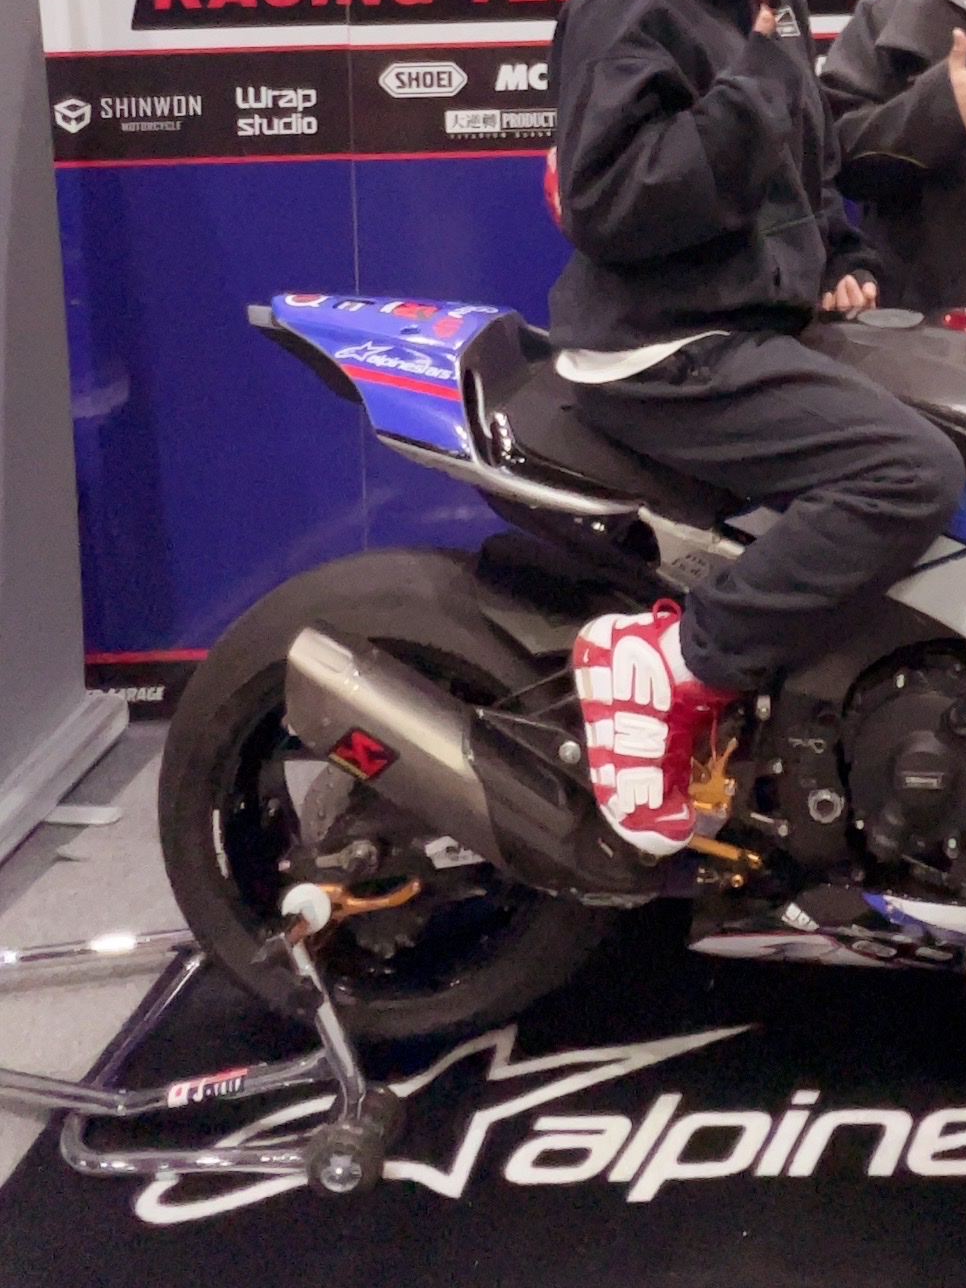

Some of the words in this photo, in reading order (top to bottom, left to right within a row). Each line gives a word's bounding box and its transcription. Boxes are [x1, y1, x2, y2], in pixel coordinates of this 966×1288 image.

[394, 70, 454, 90] SHOEI
[100, 95, 203, 119] SHINWON
[235, 86, 317, 111] Wrap
[121, 120, 182, 132] MOTORCYCLE
[237, 113, 318, 136] studio
